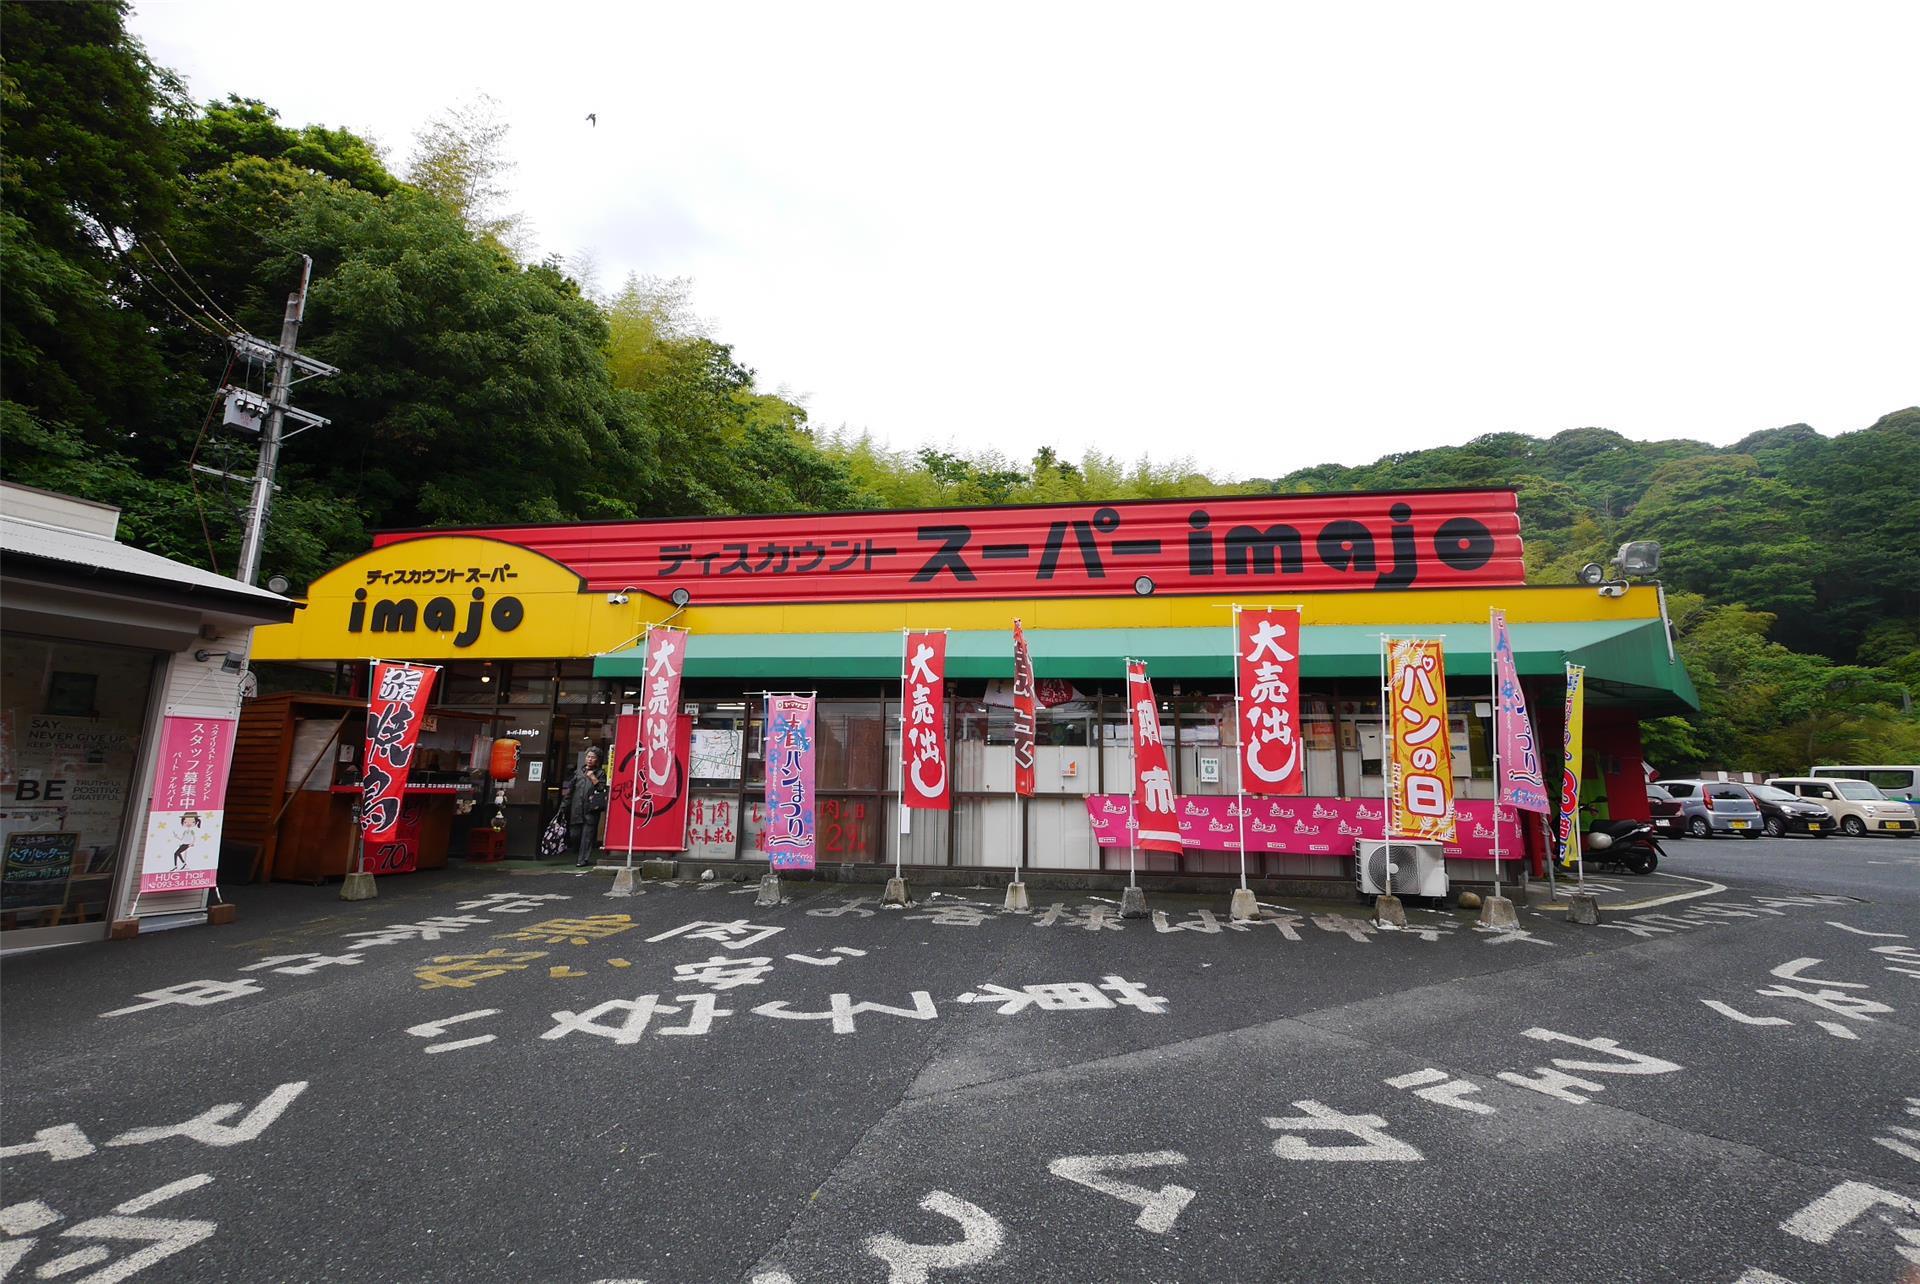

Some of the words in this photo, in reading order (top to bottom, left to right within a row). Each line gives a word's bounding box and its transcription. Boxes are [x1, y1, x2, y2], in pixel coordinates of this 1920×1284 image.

[366, 569, 465, 585] ディスカウント
[466, 563, 518, 582] スーパー
[658, 538, 897, 577] ディスカウント
[910, 506, 1161, 582] スーパー
[1188, 502, 1496, 590] imajo
[347, 586, 525, 648] imajo
[646, 639, 679, 786] 大売出し
[908, 642, 946, 799] 大売出し
[1245, 620, 1298, 782] 大売出し
[1400, 655, 1446, 817] パンの日
[15, 779, 66, 801] BE
[179, 723, 205, 809] スタッフ募集中
[155, 872, 180, 881] HUG
